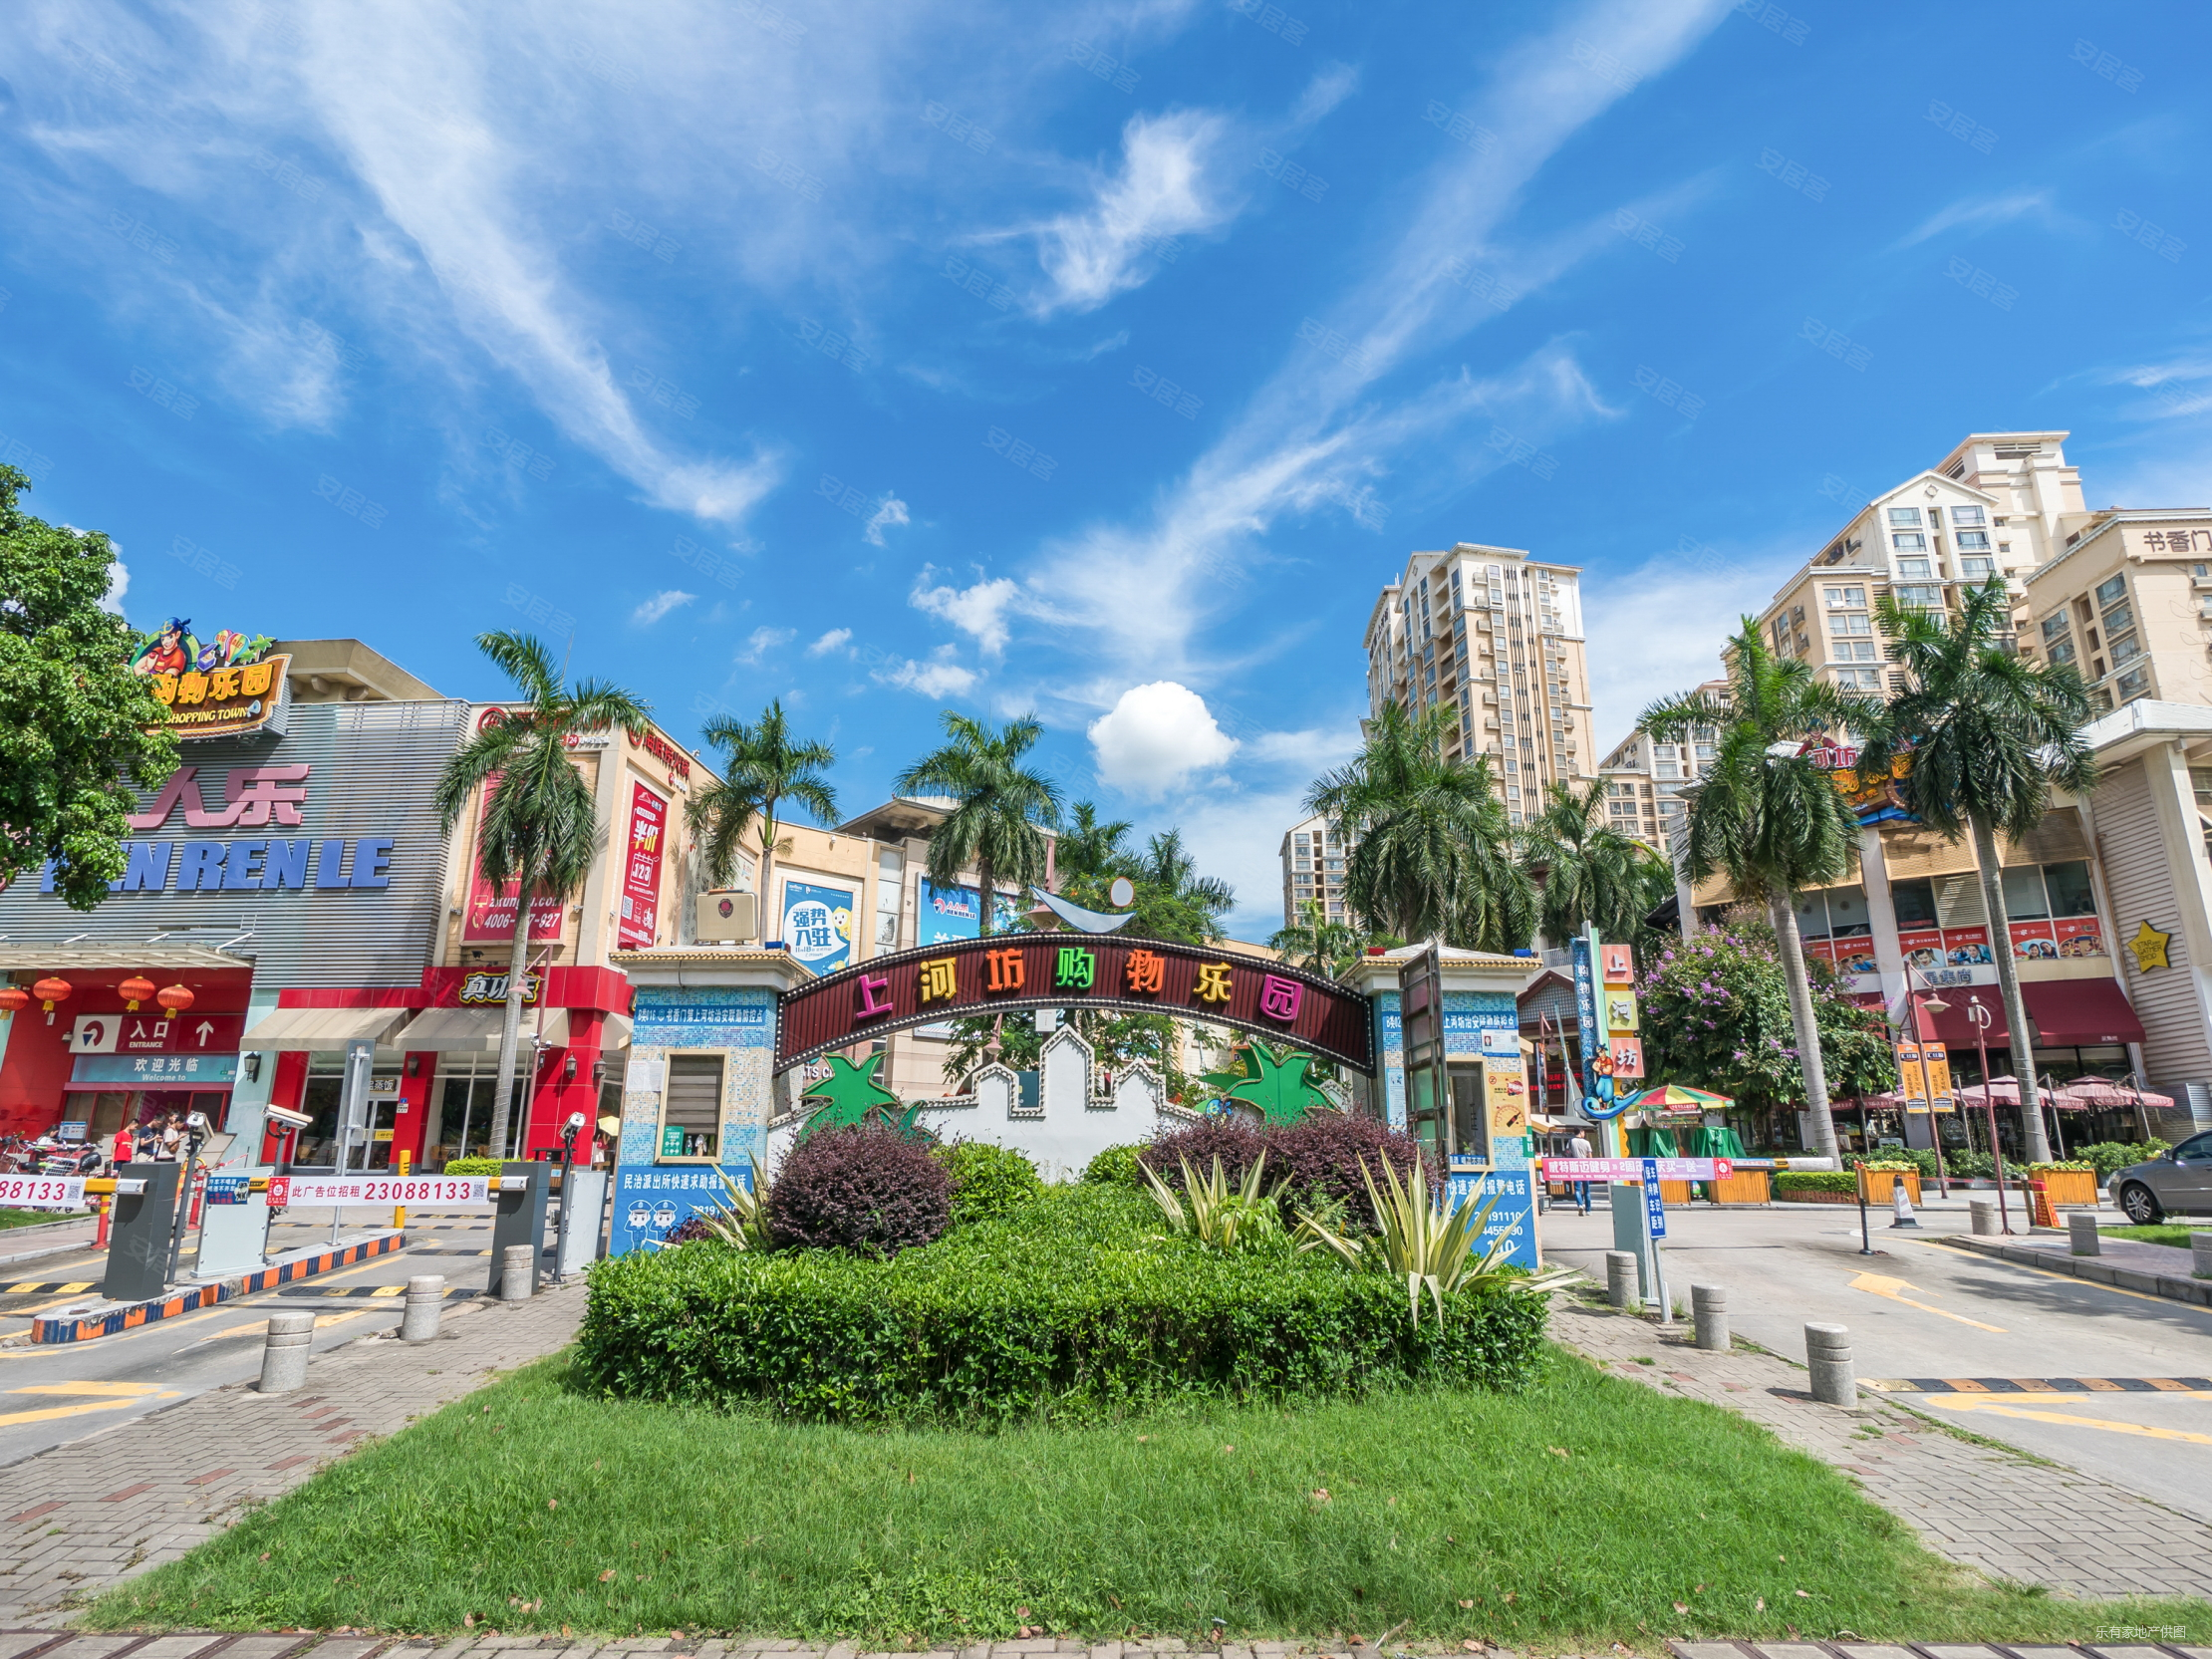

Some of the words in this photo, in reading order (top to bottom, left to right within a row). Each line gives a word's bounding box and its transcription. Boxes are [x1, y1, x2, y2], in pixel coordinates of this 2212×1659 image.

[2143, 530, 2212, 553] 书香门
[151, 664, 273, 705] 购物乐园
[165, 710, 216, 724] SHOPPING
[217, 706, 248, 720] TOWN
[484, 912, 560, 929] 4006-7-927
[793, 908, 826, 928] 强势
[795, 928, 832, 947] 入驻
[854, 947, 1302, 1022] 上河坊购物乐园
[1577, 965, 1593, 1028] 购物乐园
[1608, 954, 1638, 1067] 上河坊
[130, 1019, 169, 1039] 入口
[134, 1058, 199, 1072] 欢迎光临
[1548, 1161, 1610, 1173] 威特斯迈健身
[292, 1185, 360, 1198] 此广告位招租
[365, 1182, 471, 1201] 23088133
[1474, 1212, 1522, 1222] 2191110
